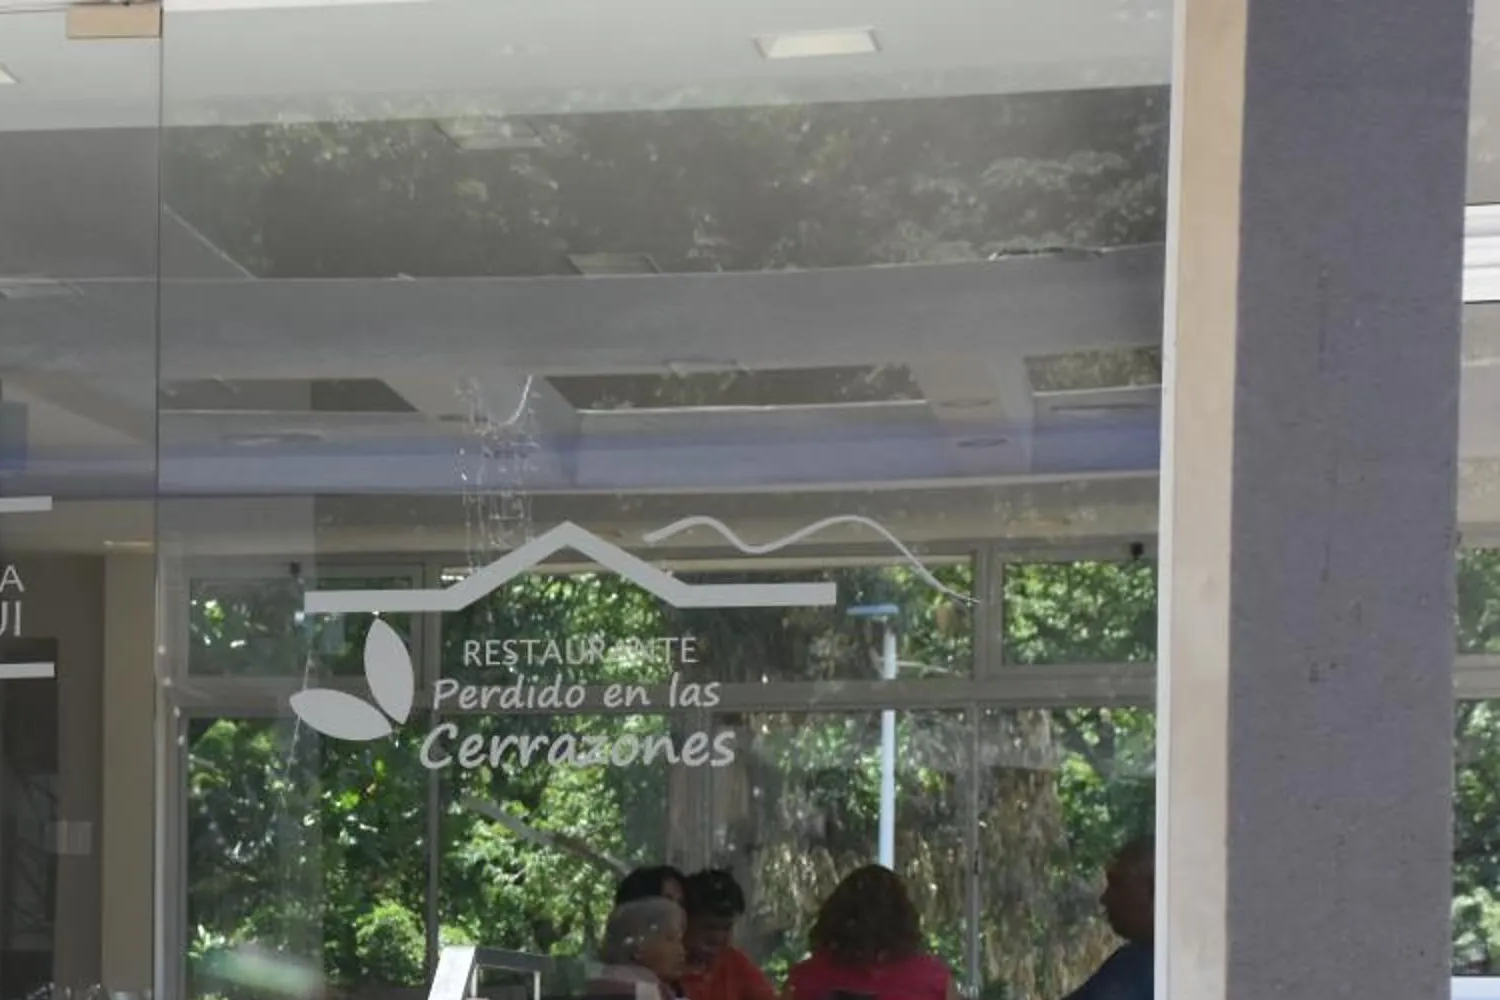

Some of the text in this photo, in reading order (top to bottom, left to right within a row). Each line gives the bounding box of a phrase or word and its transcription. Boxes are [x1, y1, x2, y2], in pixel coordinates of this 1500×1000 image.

[433, 672, 721, 710] Perdido en las
[419, 722, 737, 769] Cerrazones
